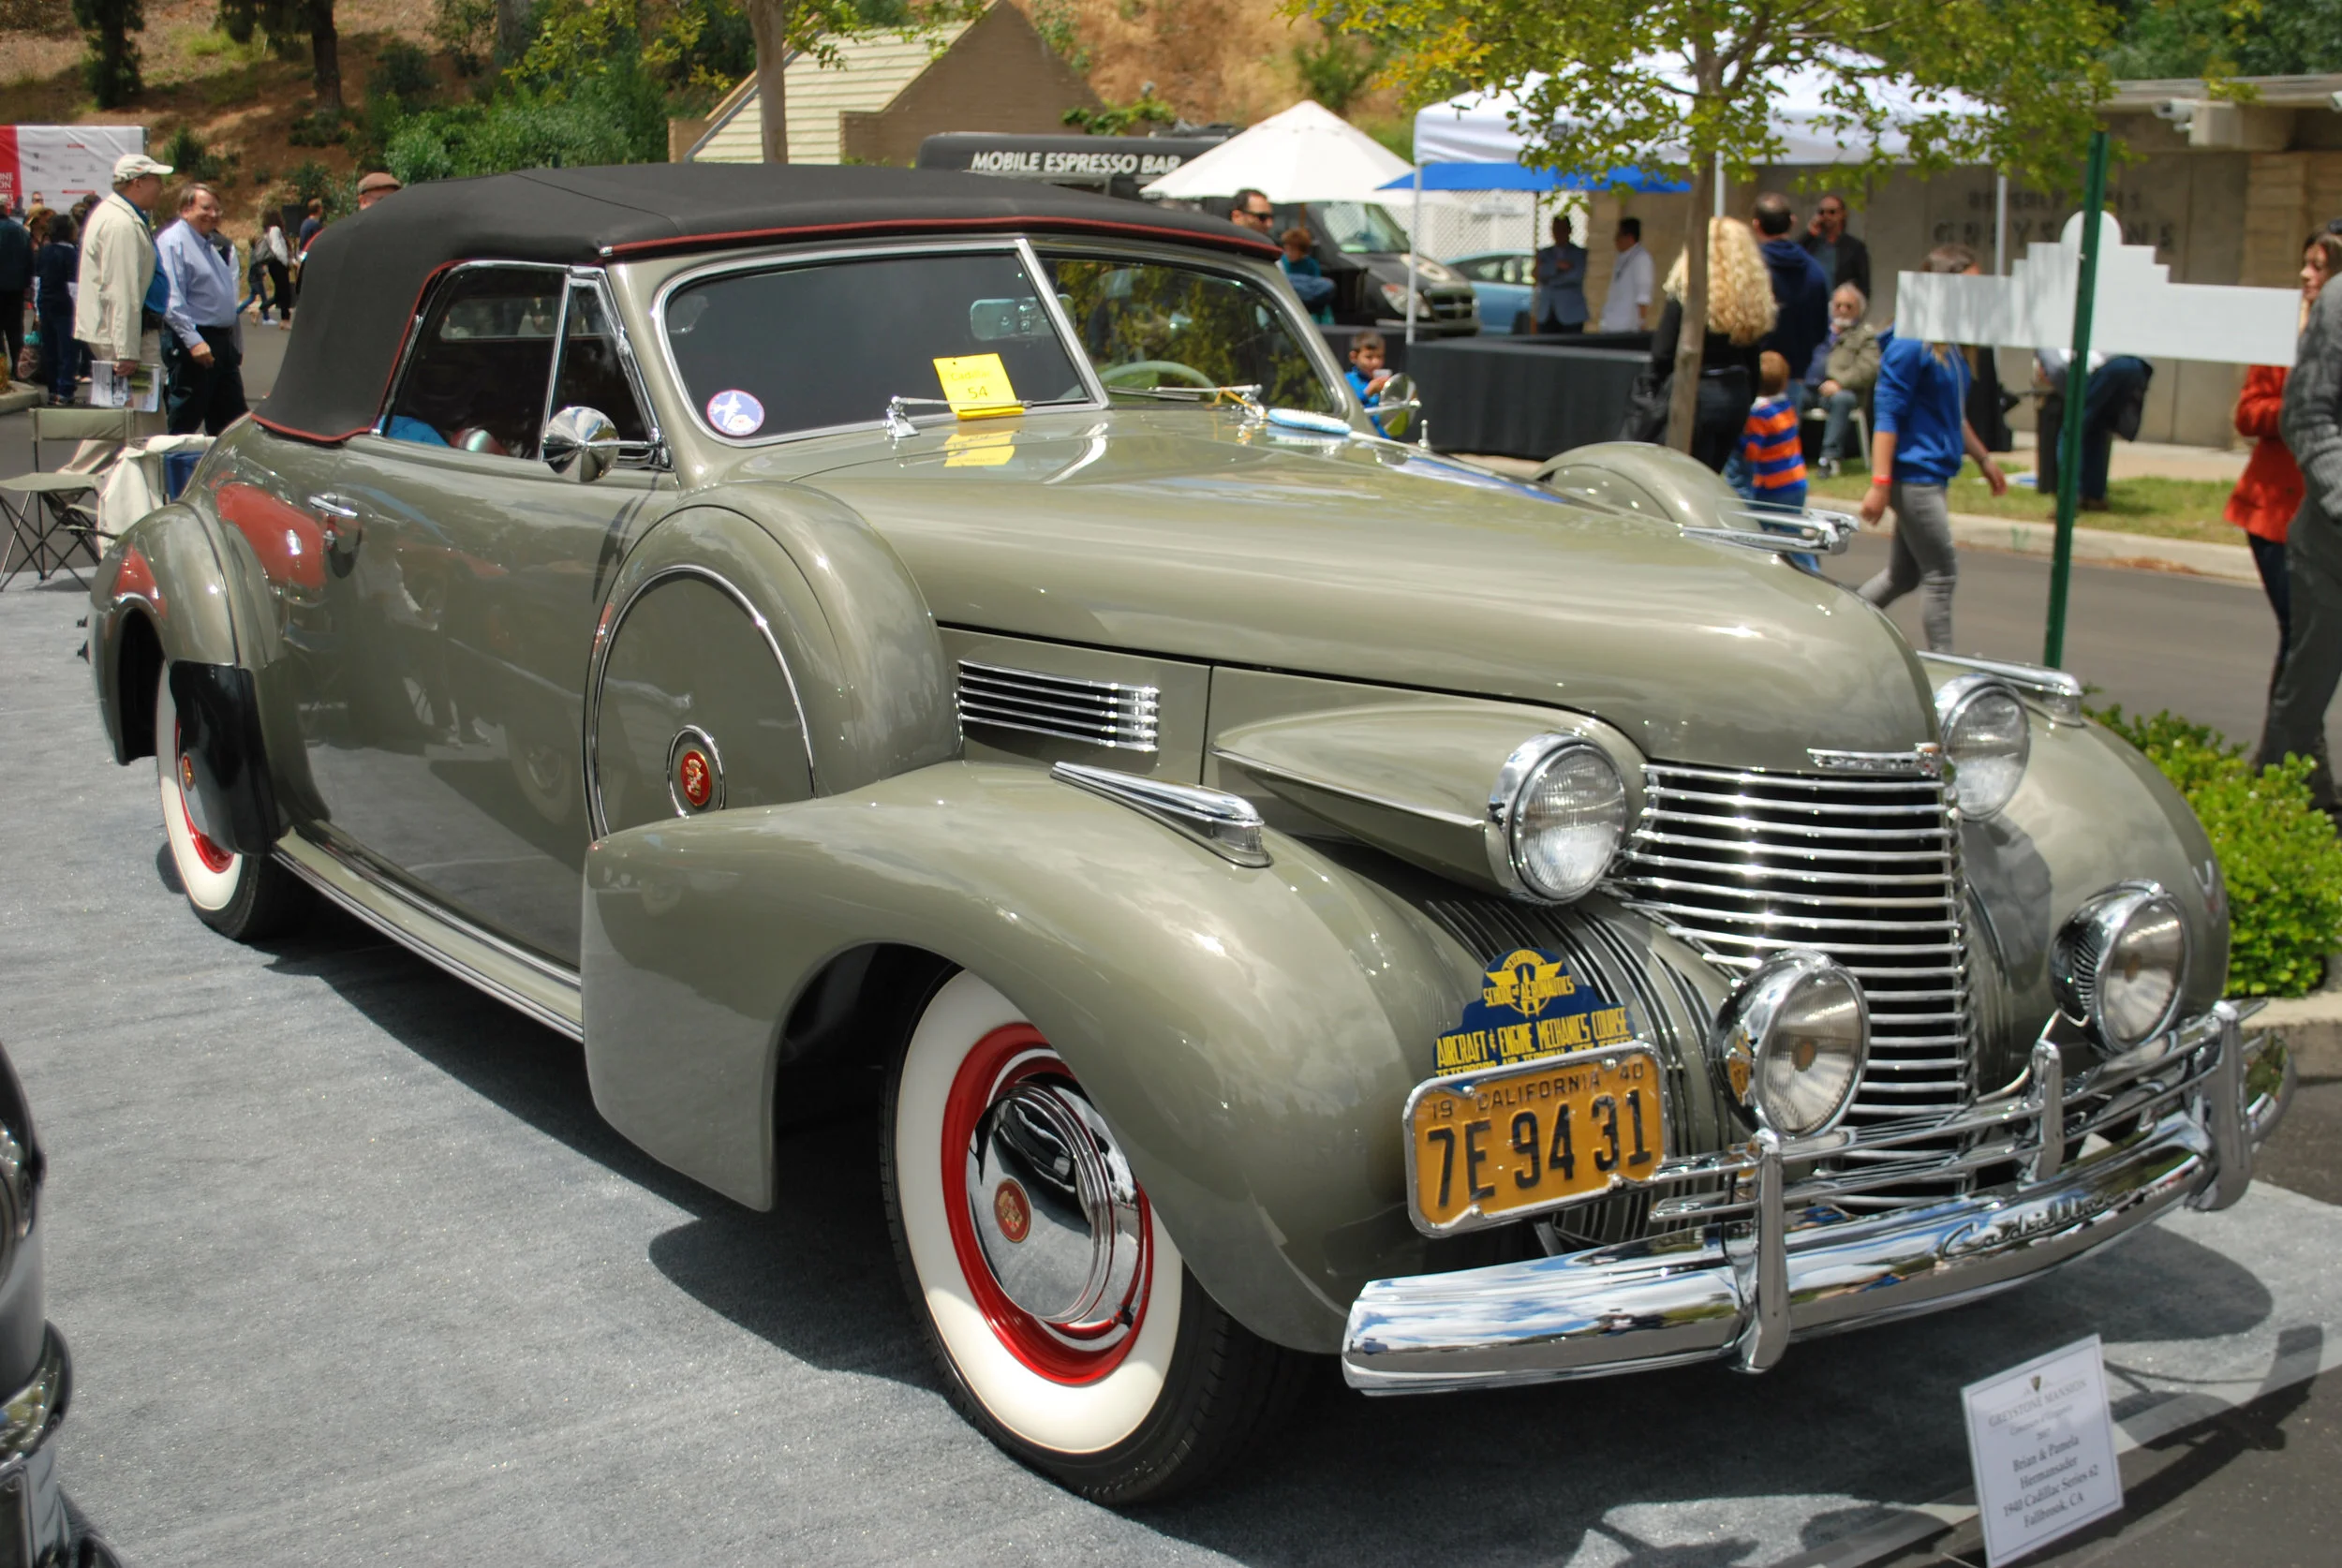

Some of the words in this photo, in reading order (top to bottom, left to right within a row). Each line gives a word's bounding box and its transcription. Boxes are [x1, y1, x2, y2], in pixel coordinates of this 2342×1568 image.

[971, 151, 1042, 171] MOBILE
[1044, 152, 1138, 174] ESPRESSO
[1140, 154, 1181, 174] BAR
[968, 385, 987, 399] 54
[1483, 984, 1516, 1008] SCHOOL
[1520, 975, 1576, 1001] AERONAUTICS
[1436, 1030, 1490, 1068] AIRCRAFT
[1489, 1028, 1497, 1053] &
[1497, 1022, 1536, 1057] ENGINE
[1591, 1007, 1630, 1041] COURSE
[1431, 1099, 1452, 1120] 19
[1476, 1072, 1601, 1113] CALIFORNIA
[1619, 1062, 1644, 1080] 40
[1942, 1192, 2117, 1258] Cadillac
[2012, 1455, 2037, 1472] Brian
[2048, 1434, 2079, 1457] Pamela
[2024, 1484, 2060, 1507] Cadillac
[2061, 1472, 2087, 1491] Series
[2068, 1491, 2084, 1507] CA
